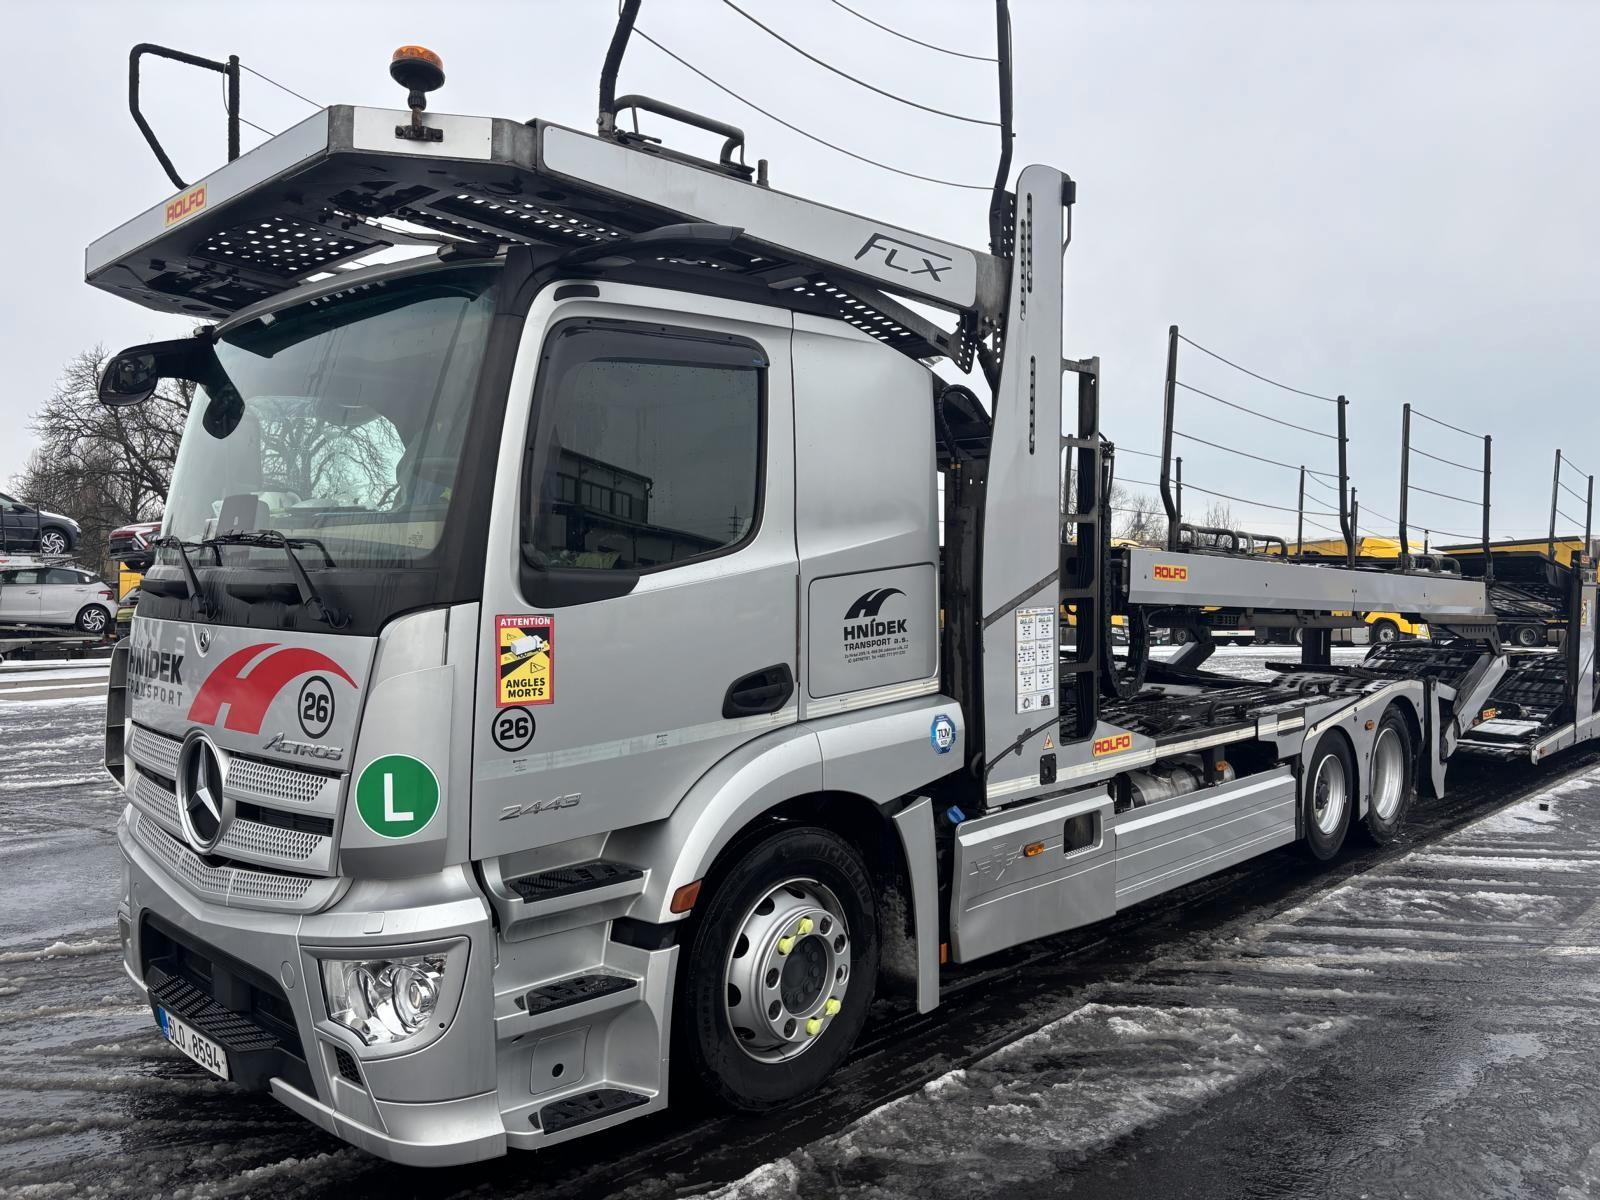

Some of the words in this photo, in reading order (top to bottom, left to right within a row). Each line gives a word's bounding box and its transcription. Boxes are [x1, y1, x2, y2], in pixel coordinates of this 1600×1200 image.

[167, 187, 205, 223] ROLFO
[854, 232, 952, 282] FLX
[1154, 566, 1187, 580] ROLFO
[500, 617, 551, 627] ATTENTION
[844, 617, 908, 641] HNÍDEK
[844, 638, 892, 651] TRANSPORT
[128, 640, 184, 686] HNÍDEK
[127, 678, 183, 707] TRANSPORT
[506, 677, 546, 689] ANGLES
[508, 687, 544, 699] MORTS
[303, 692, 330, 723] 26
[500, 717, 529, 741] 26
[1094, 735, 1131, 755] ROLFO
[384, 773, 414, 822] L
[191, 1034, 221, 1073] 8594
